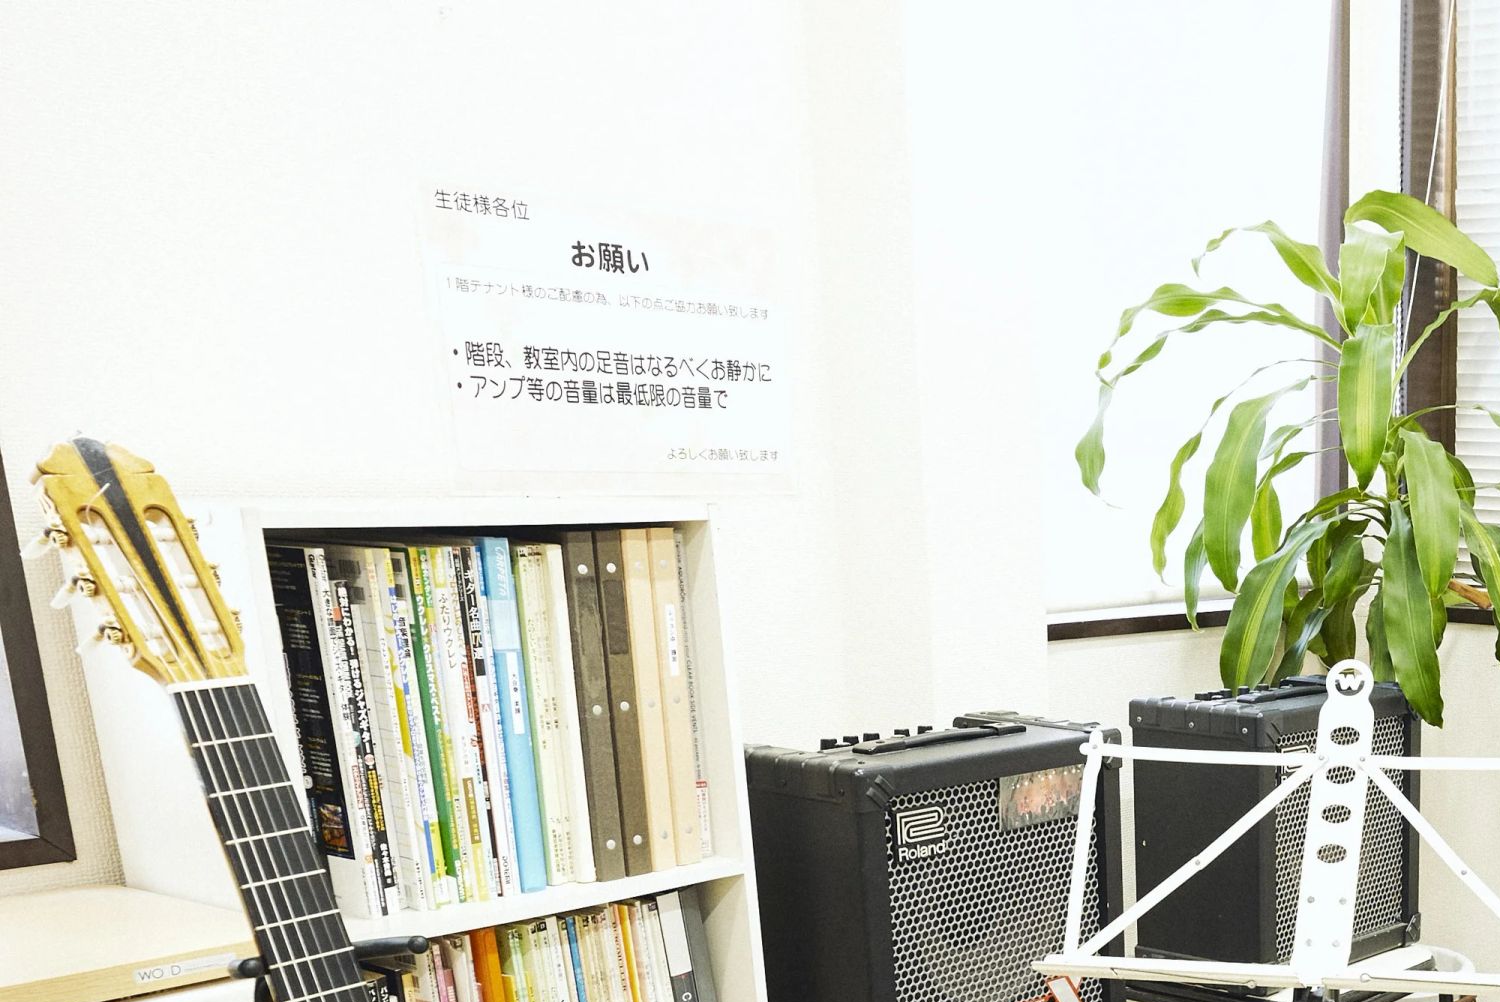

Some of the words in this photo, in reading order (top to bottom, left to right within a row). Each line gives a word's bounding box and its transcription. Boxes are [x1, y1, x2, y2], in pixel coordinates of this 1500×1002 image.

[434, 188, 530, 221] 生徒様各位
[571, 241, 650, 275] お願い
[667, 447, 778, 462] よろしくお願い致します
[439, 593, 457, 669] ふたりウクレレ
[899, 840, 946, 862] Roland
